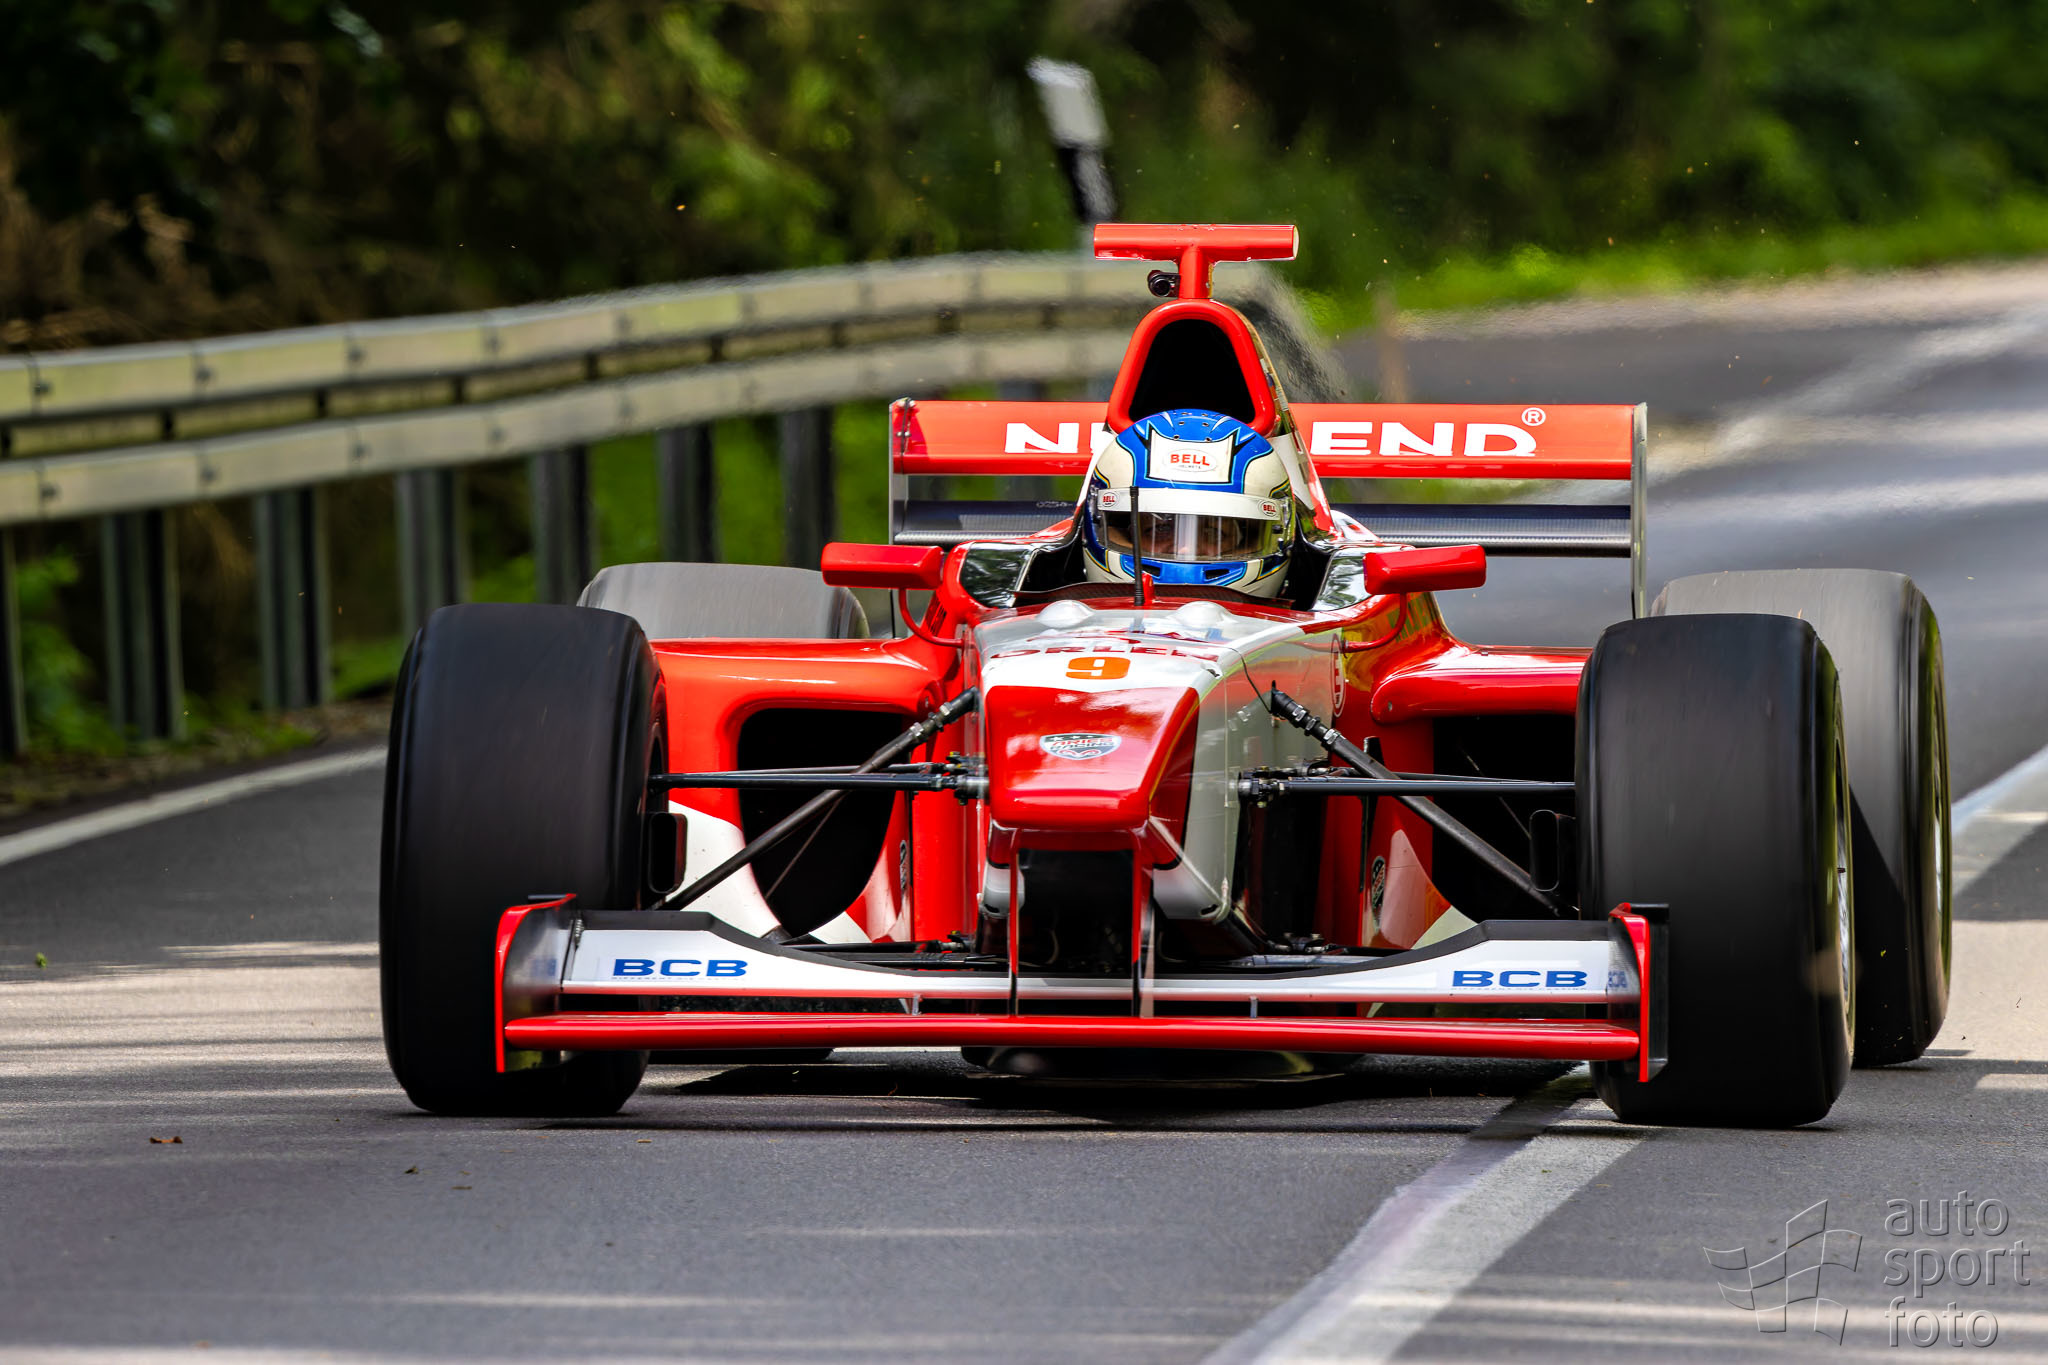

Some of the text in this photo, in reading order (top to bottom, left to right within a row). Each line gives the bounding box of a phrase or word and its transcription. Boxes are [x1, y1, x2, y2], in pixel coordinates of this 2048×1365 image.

[1170, 454, 1210, 466] BELL
[1103, 495, 1116, 503] BELL
[1263, 504, 1276, 513] BELL
[990, 645, 1219, 663] ORLEN
[1065, 656, 1131, 680] 9
[613, 958, 748, 977] BCB
[1452, 970, 1588, 987] BCB
